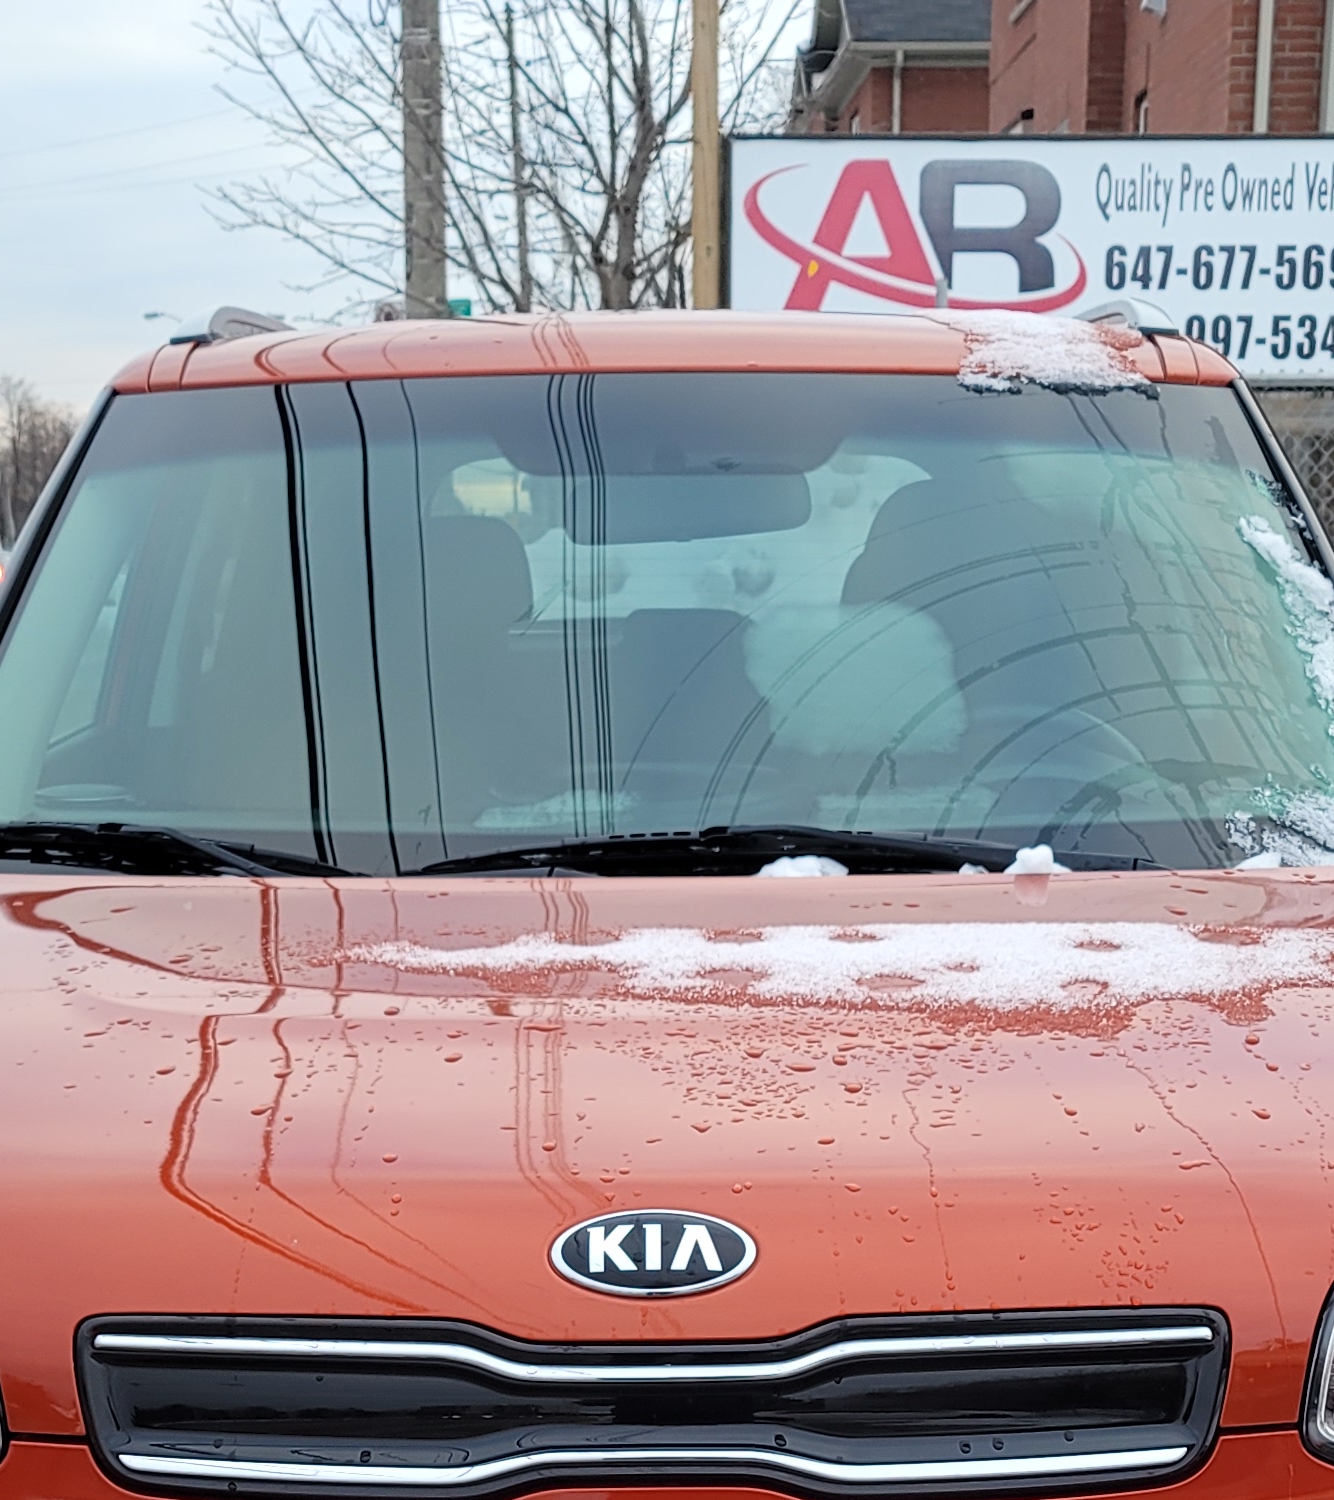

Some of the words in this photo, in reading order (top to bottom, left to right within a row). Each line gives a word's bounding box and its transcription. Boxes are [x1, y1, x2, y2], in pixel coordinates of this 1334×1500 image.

[1095, 162, 1174, 228] Quality
[1178, 162, 1214, 213] Pre
[1221, 161, 1296, 212] Owned
[586, 1222, 724, 1274] KIA
